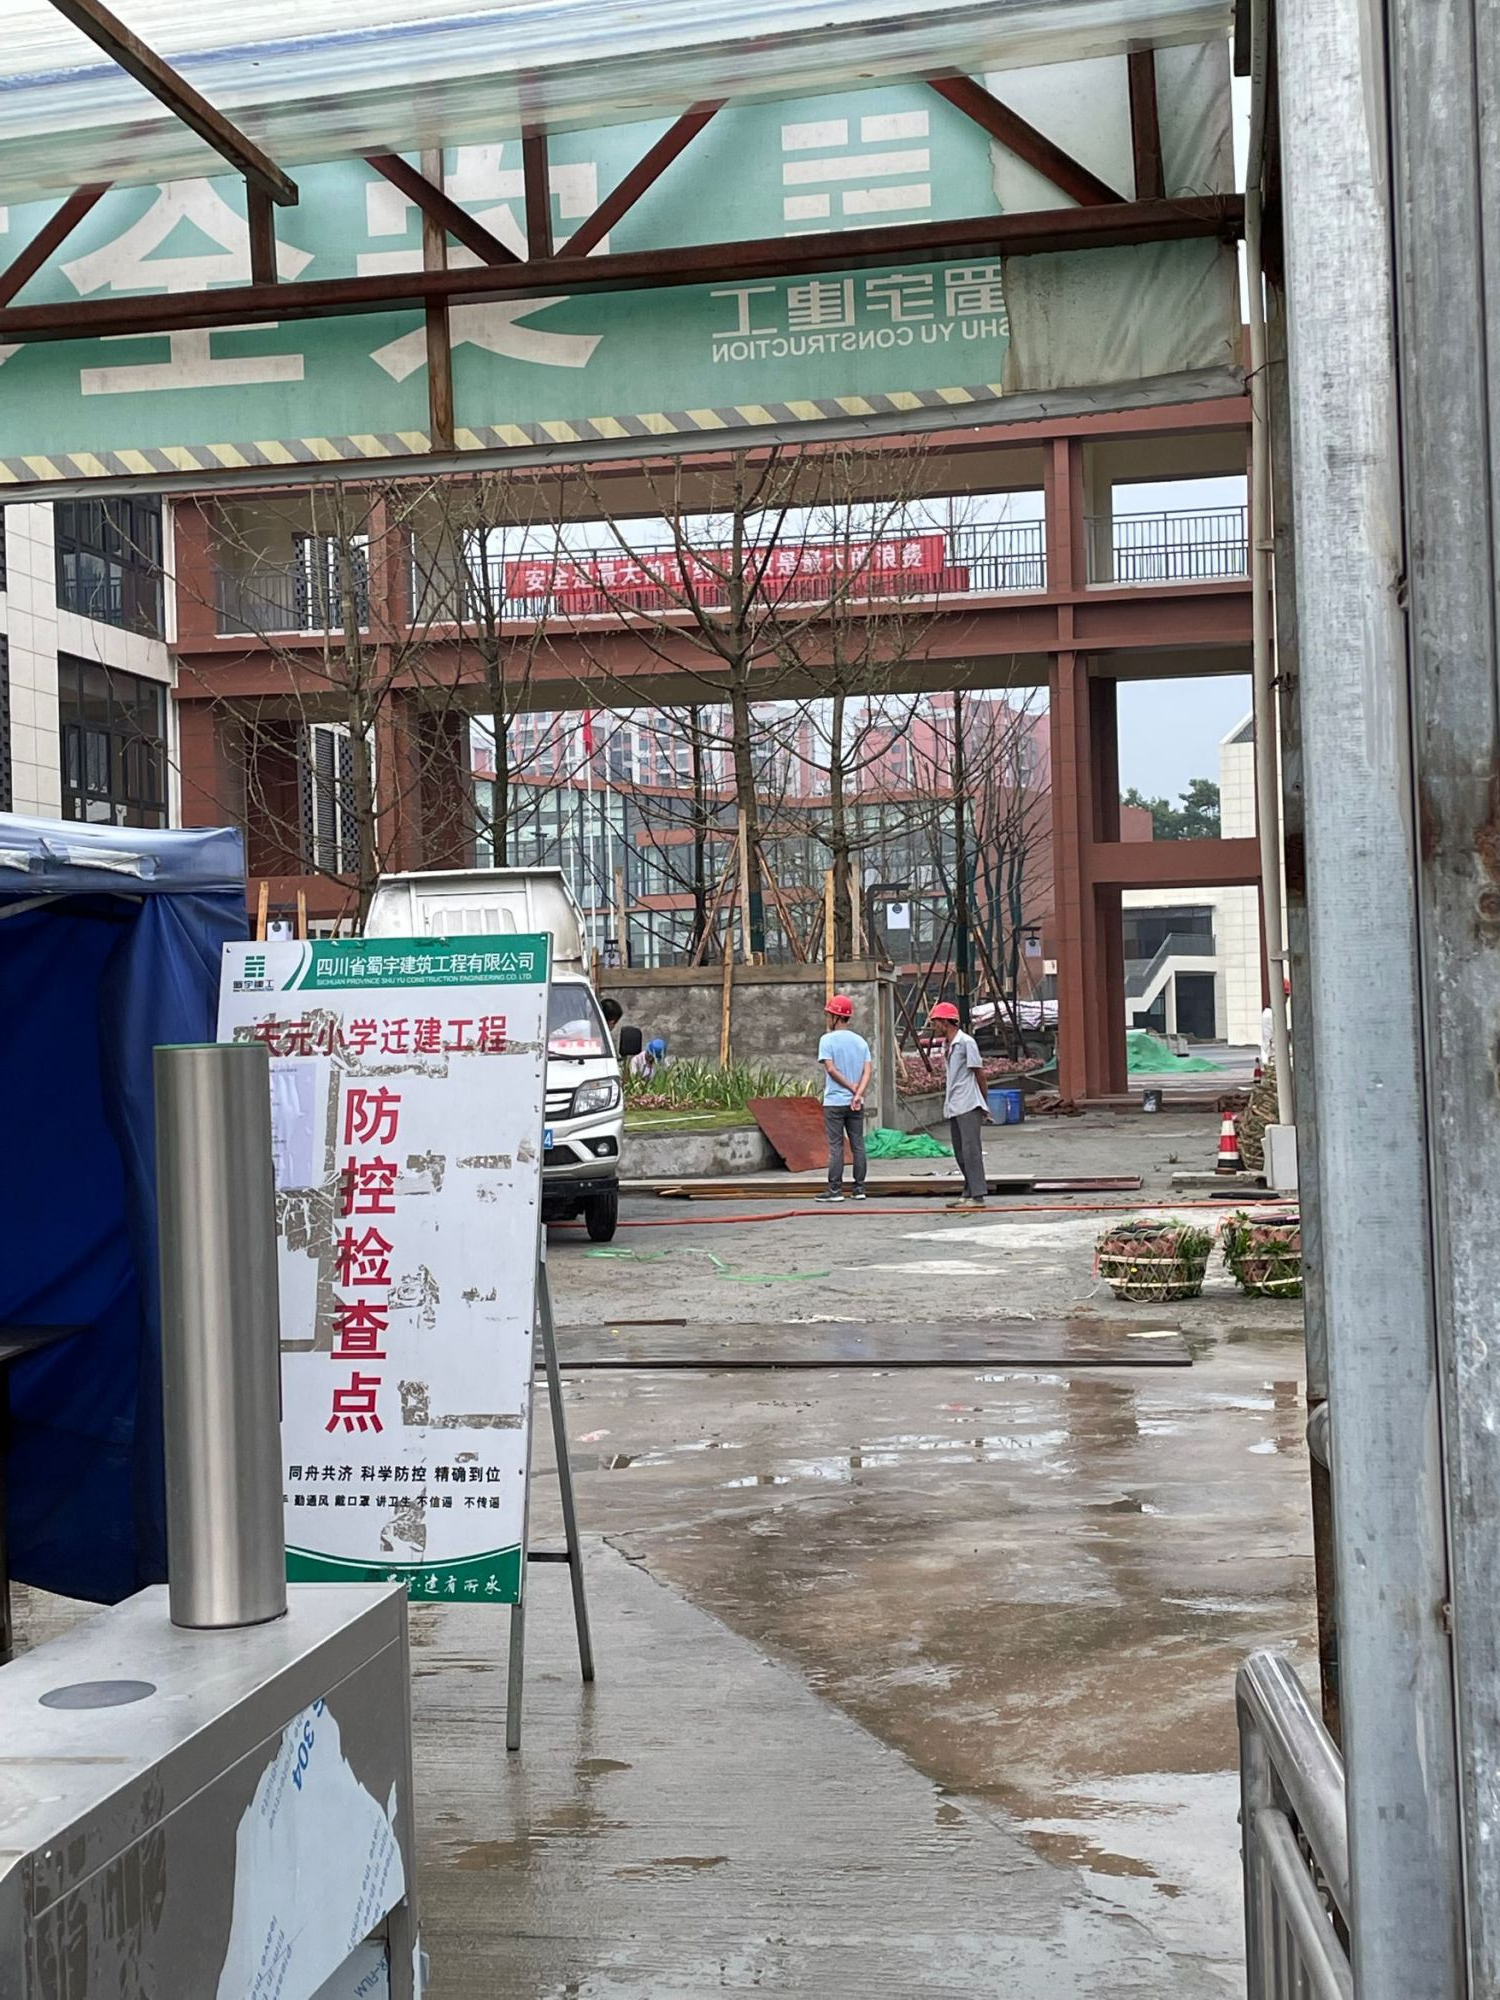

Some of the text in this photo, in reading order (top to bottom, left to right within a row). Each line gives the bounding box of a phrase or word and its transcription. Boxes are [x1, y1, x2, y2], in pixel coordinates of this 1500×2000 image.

[316, 951, 535, 977] 四川省蜀宇建筑工程有限公司
[316, 978, 346, 986] SICHUAN
[346, 977, 381, 985] PROVINCE
[381, 976, 395, 984] SHU
[396, 976, 406, 984] YU
[406, 975, 458, 984] CONSTRUCTION
[459, 974, 505, 982] ENGINEERING
[254, 1015, 508, 1058] 天元小学迁建工程
[325, 1086, 402, 1433] 防控检查点
[288, 1465, 501, 1483] 同舟共济 科学防控 精确到位
[334, 1494, 371, 1507] 戴口罩
[376, 1495, 411, 1508] 讲卫生
[417, 1495, 453, 1508] 不信谣
[464, 1496, 500, 1509] 不传谣
[292, 1720, 315, 1791] 304
[354, 1956, 388, 1998] R-FILM
